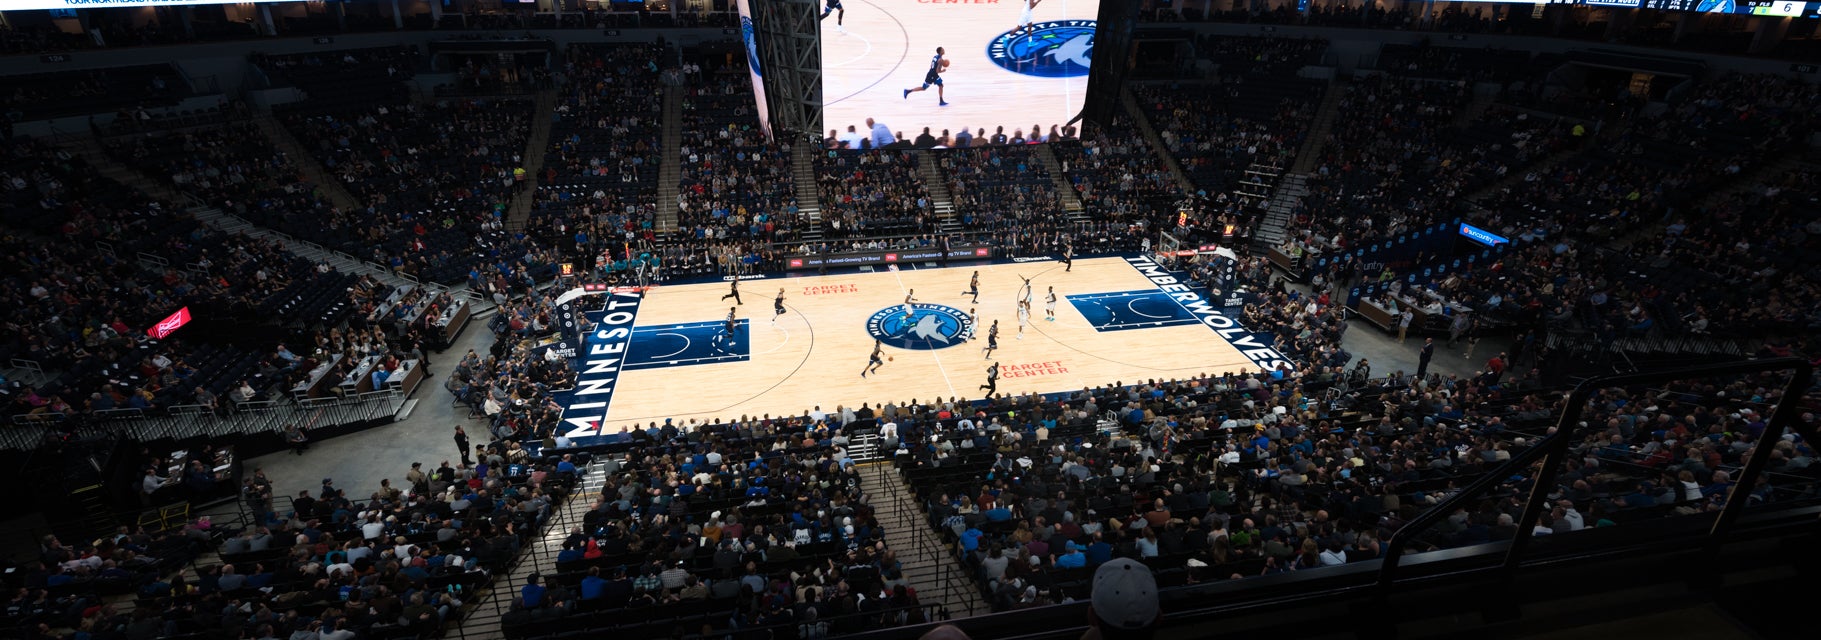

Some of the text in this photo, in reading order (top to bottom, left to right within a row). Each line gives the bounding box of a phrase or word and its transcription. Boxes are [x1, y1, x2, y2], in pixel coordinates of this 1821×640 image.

[1784, 3, 1793, 12] 6
[803, 283, 858, 292] TARGET
[803, 287, 859, 296] CENTER
[1127, 254, 1294, 372] TIMBERWOLVES
[1000, 360, 1062, 372] TARGET
[1002, 367, 1069, 379] CENTER
